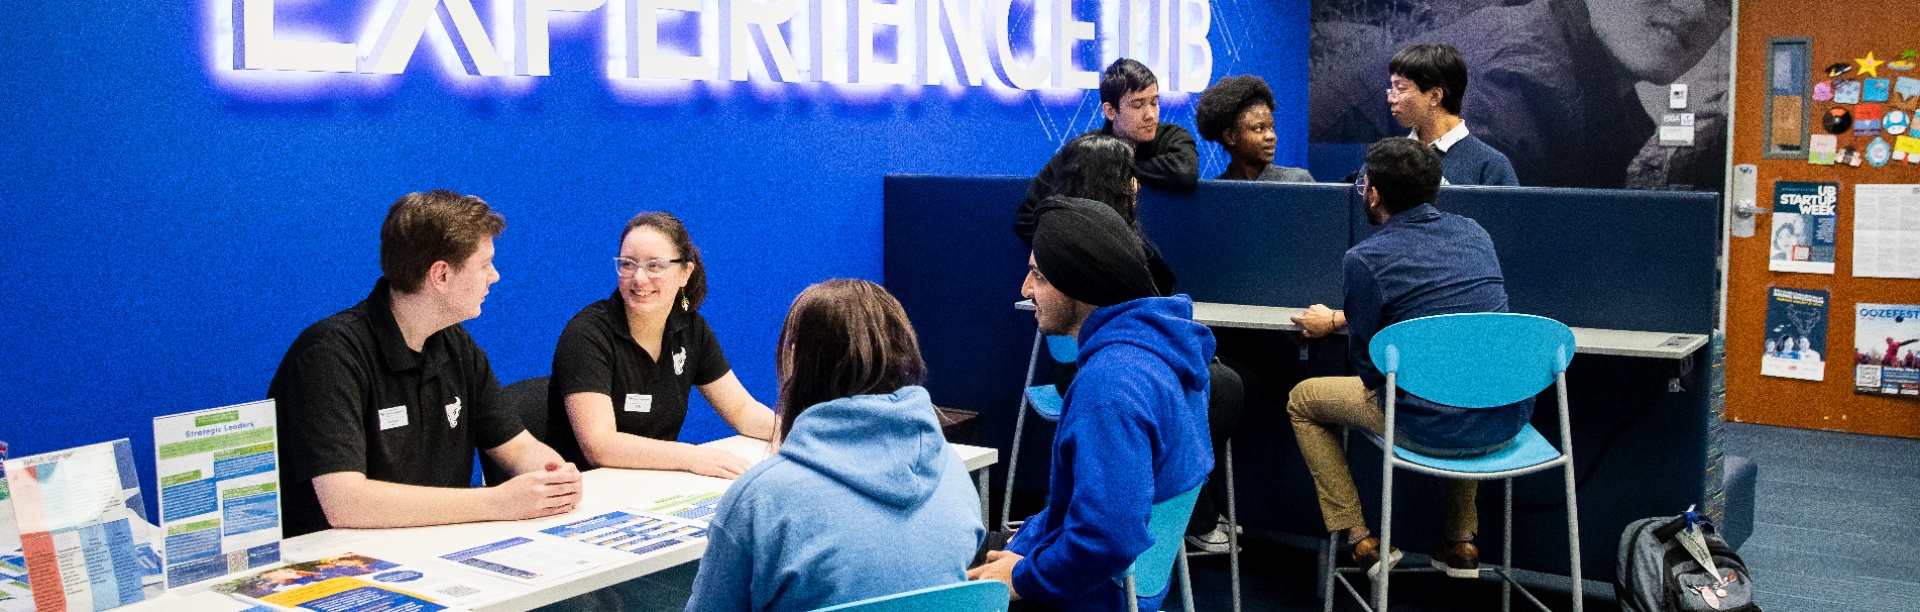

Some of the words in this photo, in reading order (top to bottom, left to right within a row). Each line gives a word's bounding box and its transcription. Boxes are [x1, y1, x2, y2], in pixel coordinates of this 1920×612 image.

[1818, 185, 1837, 197] UB
[1780, 193, 1837, 206] STARTUP
[1799, 204, 1836, 216] WEEK
[1859, 308, 1920, 319] OOZEFEST
[185, 426, 222, 438] Strategic
[224, 421, 255, 432] Leaders
